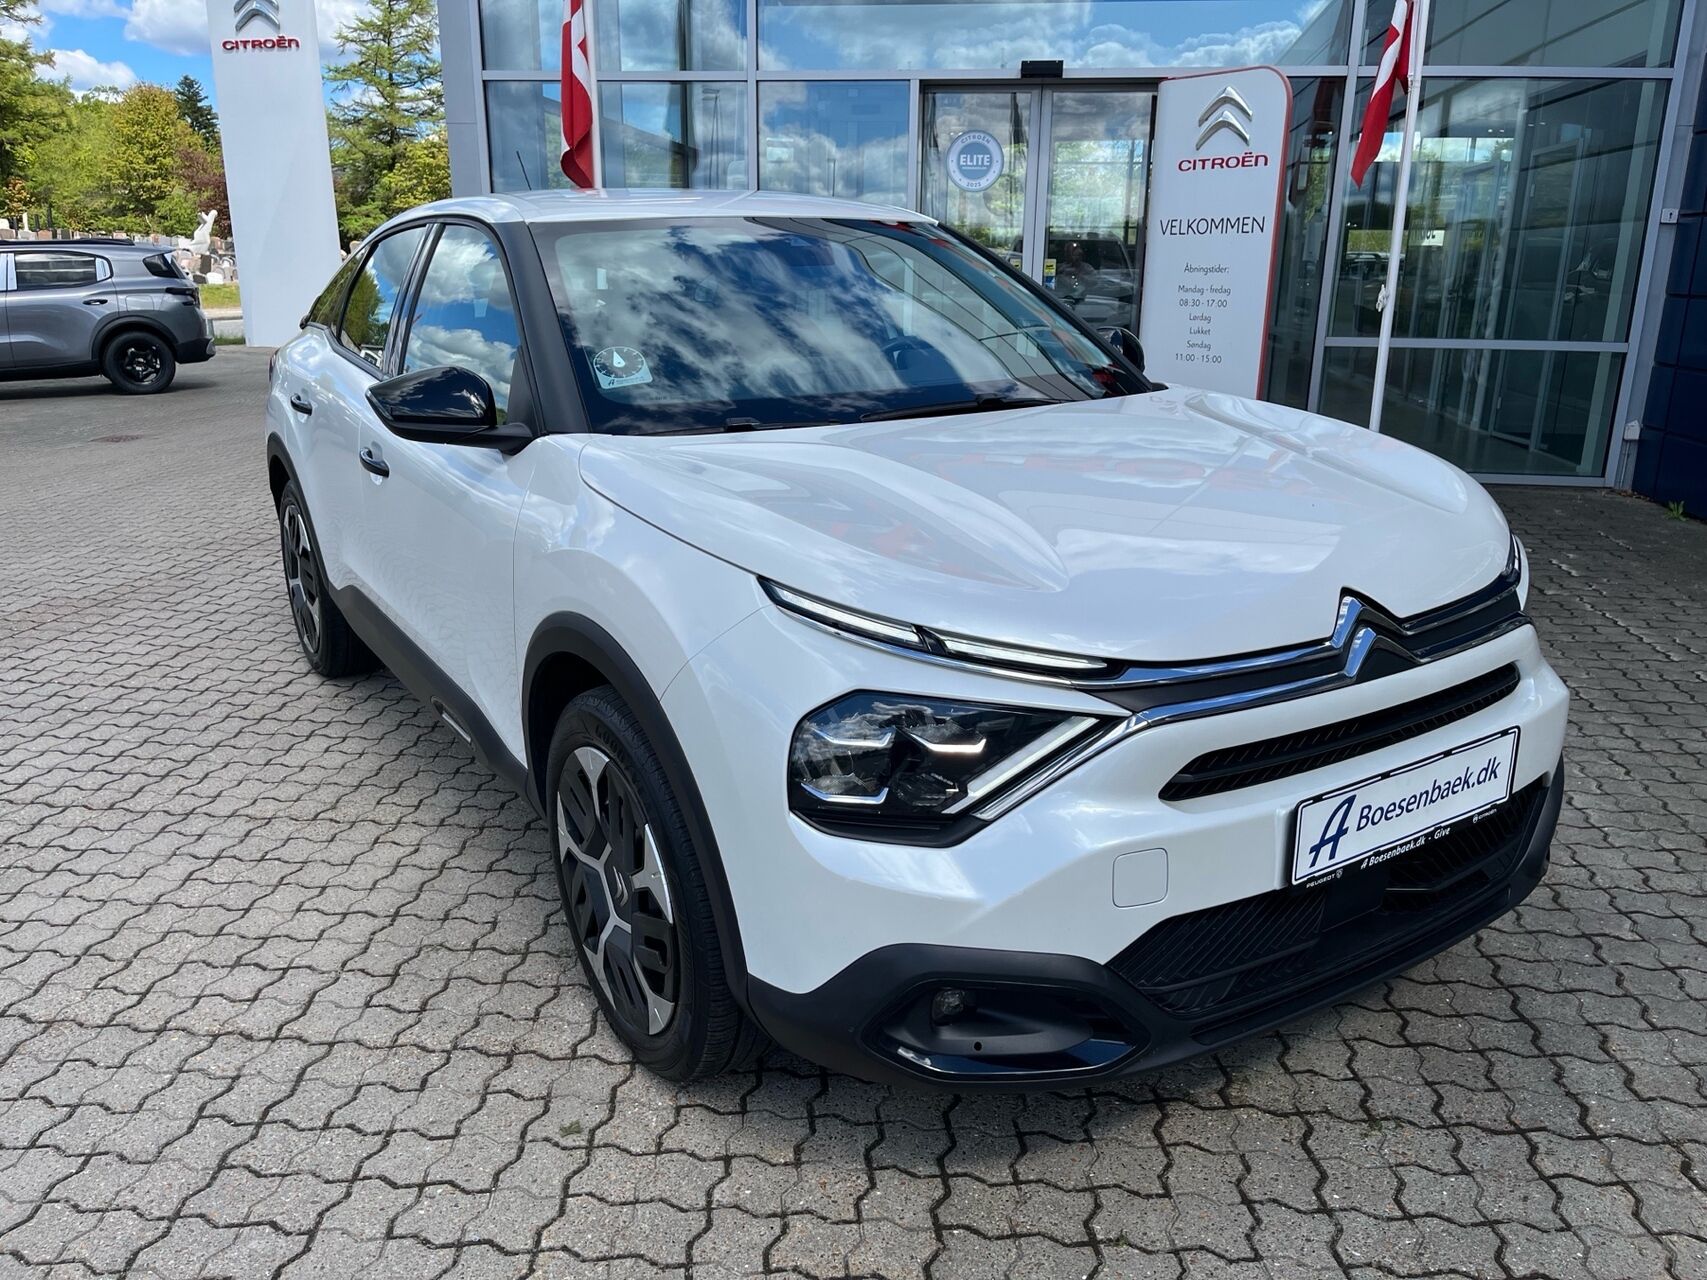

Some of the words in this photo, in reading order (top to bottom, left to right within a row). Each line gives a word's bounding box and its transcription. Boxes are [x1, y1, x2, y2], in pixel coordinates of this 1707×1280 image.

[960, 154, 990, 166] ELITE
[1160, 216, 1265, 235] VELKOMMEN
[1184, 262, 1229, 275] Åbningstider:
[1178, 285, 1204, 295] Mandag
[1210, 285, 1231, 296] fredag
[1179, 299, 1200, 307] 08:30
[1207, 299, 1227, 308] 17:00
[1189, 313, 1211, 324] Lørdag
[1189, 326, 1211, 335] Lukket
[1187, 340, 1211, 351] Søndag
[1175, 353, 1195, 361] 11:00
[1201, 354, 1222, 363] 15:00
[1309, 794, 1357, 869] A
[1356, 756, 1501, 832] Boesenbaek.dk
[1368, 835, 1426, 867] Boesenbaek.dk
[1434, 826, 1451, 840] Give
[1306, 873, 1336, 889] PEUGEOT
